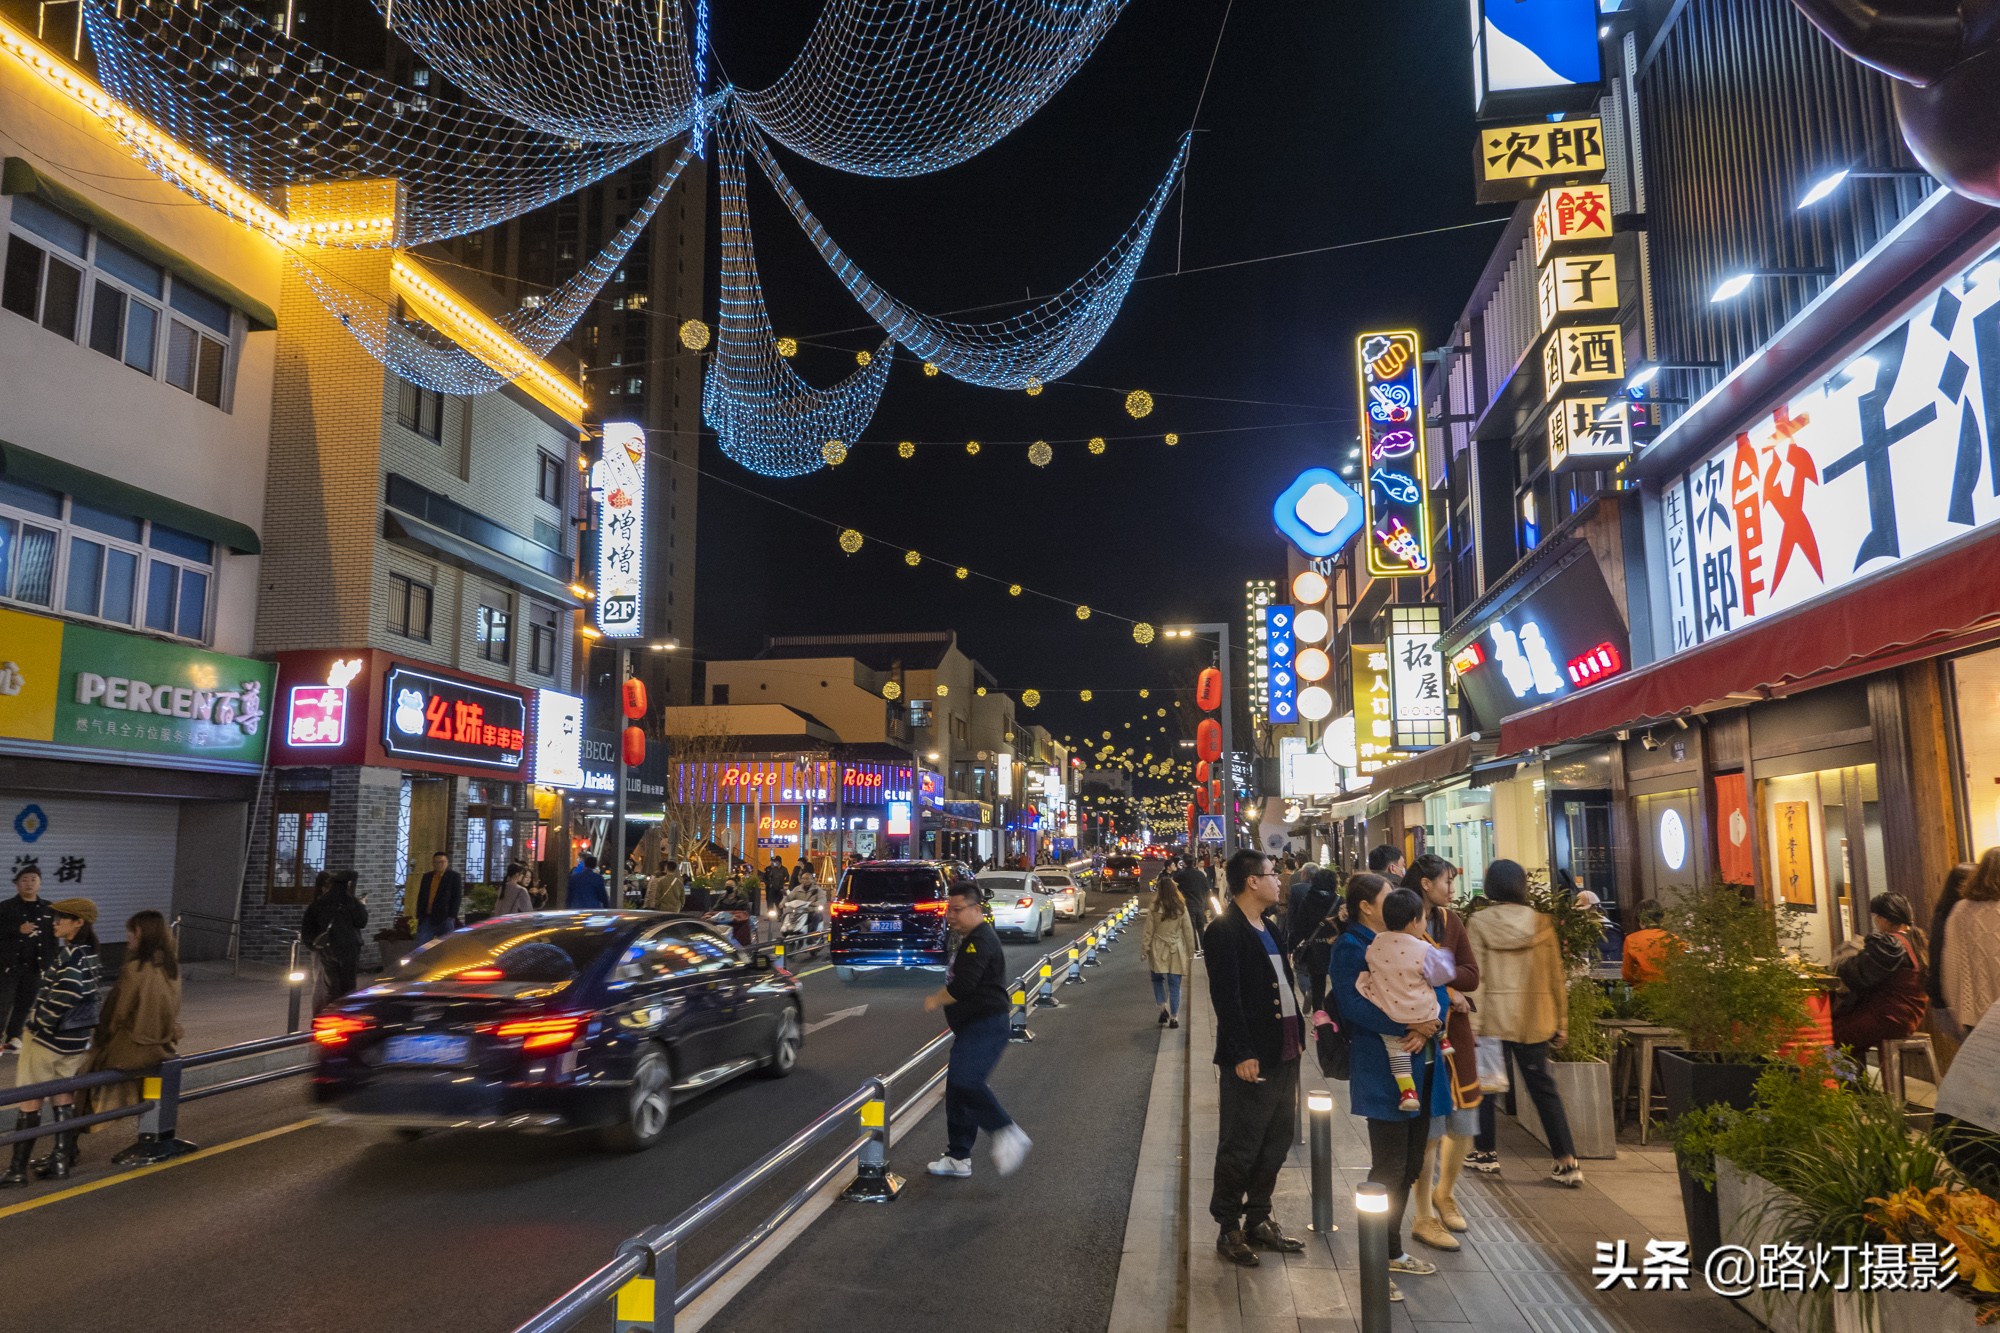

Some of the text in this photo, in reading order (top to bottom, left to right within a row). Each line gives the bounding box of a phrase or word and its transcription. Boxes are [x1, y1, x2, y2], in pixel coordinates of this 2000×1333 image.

[1487, 126, 1602, 172] 次郎
[1556, 190, 1626, 448] 餃子酒場
[1696, 459, 1739, 637] 次郎
[1666, 489, 1694, 650] 生ビール
[605, 600, 634, 620] 2F
[1400, 639, 1441, 700] 拓屋
[625, 777, 642, 793] LUB
[722, 768, 778, 787] Rose
[843, 767, 883, 787] Rose
[782, 789, 828, 800] CLUB
[759, 816, 798, 830] Rose
